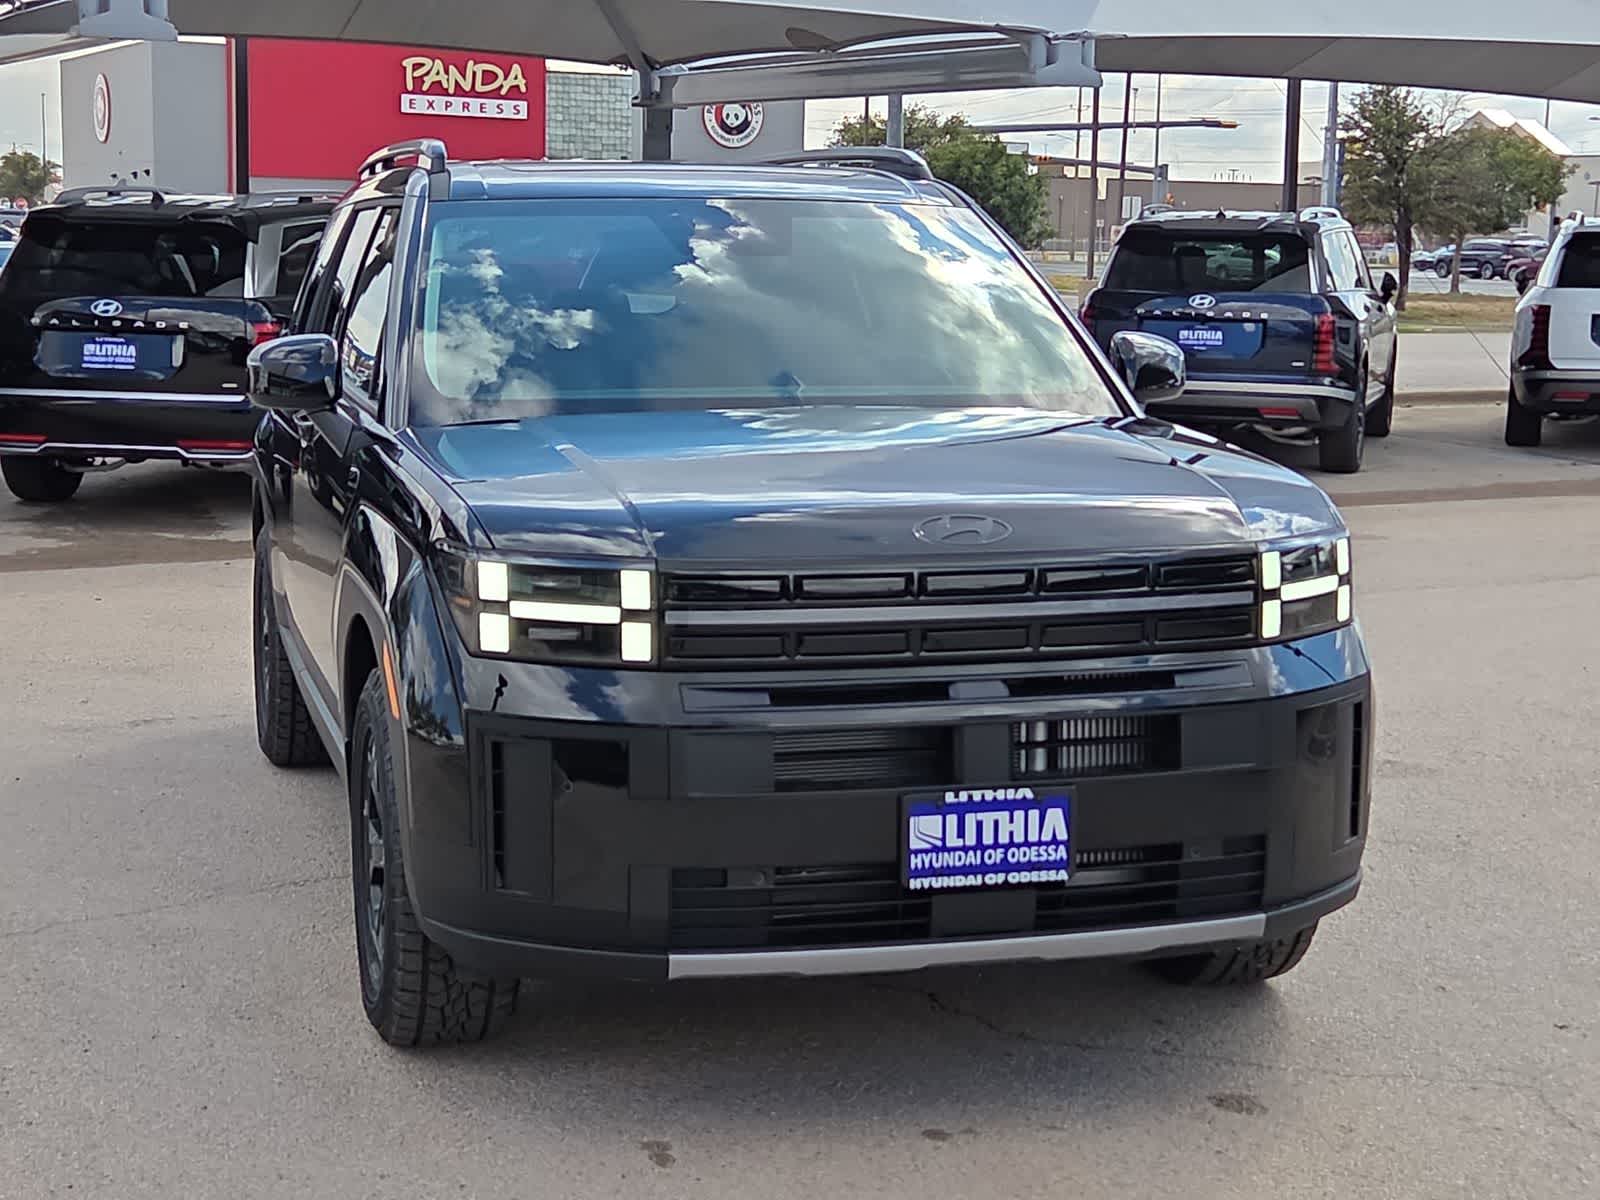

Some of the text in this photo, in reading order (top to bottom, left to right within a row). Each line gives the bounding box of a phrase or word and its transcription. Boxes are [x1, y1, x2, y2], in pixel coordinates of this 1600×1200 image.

[401, 56, 527, 95] PANDA
[408, 98, 521, 115] EXPRESS
[1189, 330, 1223, 340] LITHIA
[95, 343, 136, 357] LITHIA
[945, 787, 1034, 804] LITHIA
[945, 807, 1069, 848] LITHIA
[910, 844, 1068, 870] HYUNDAI OF ODESSA
[909, 869, 1069, 890] HYUNDAI OF ODESSA
